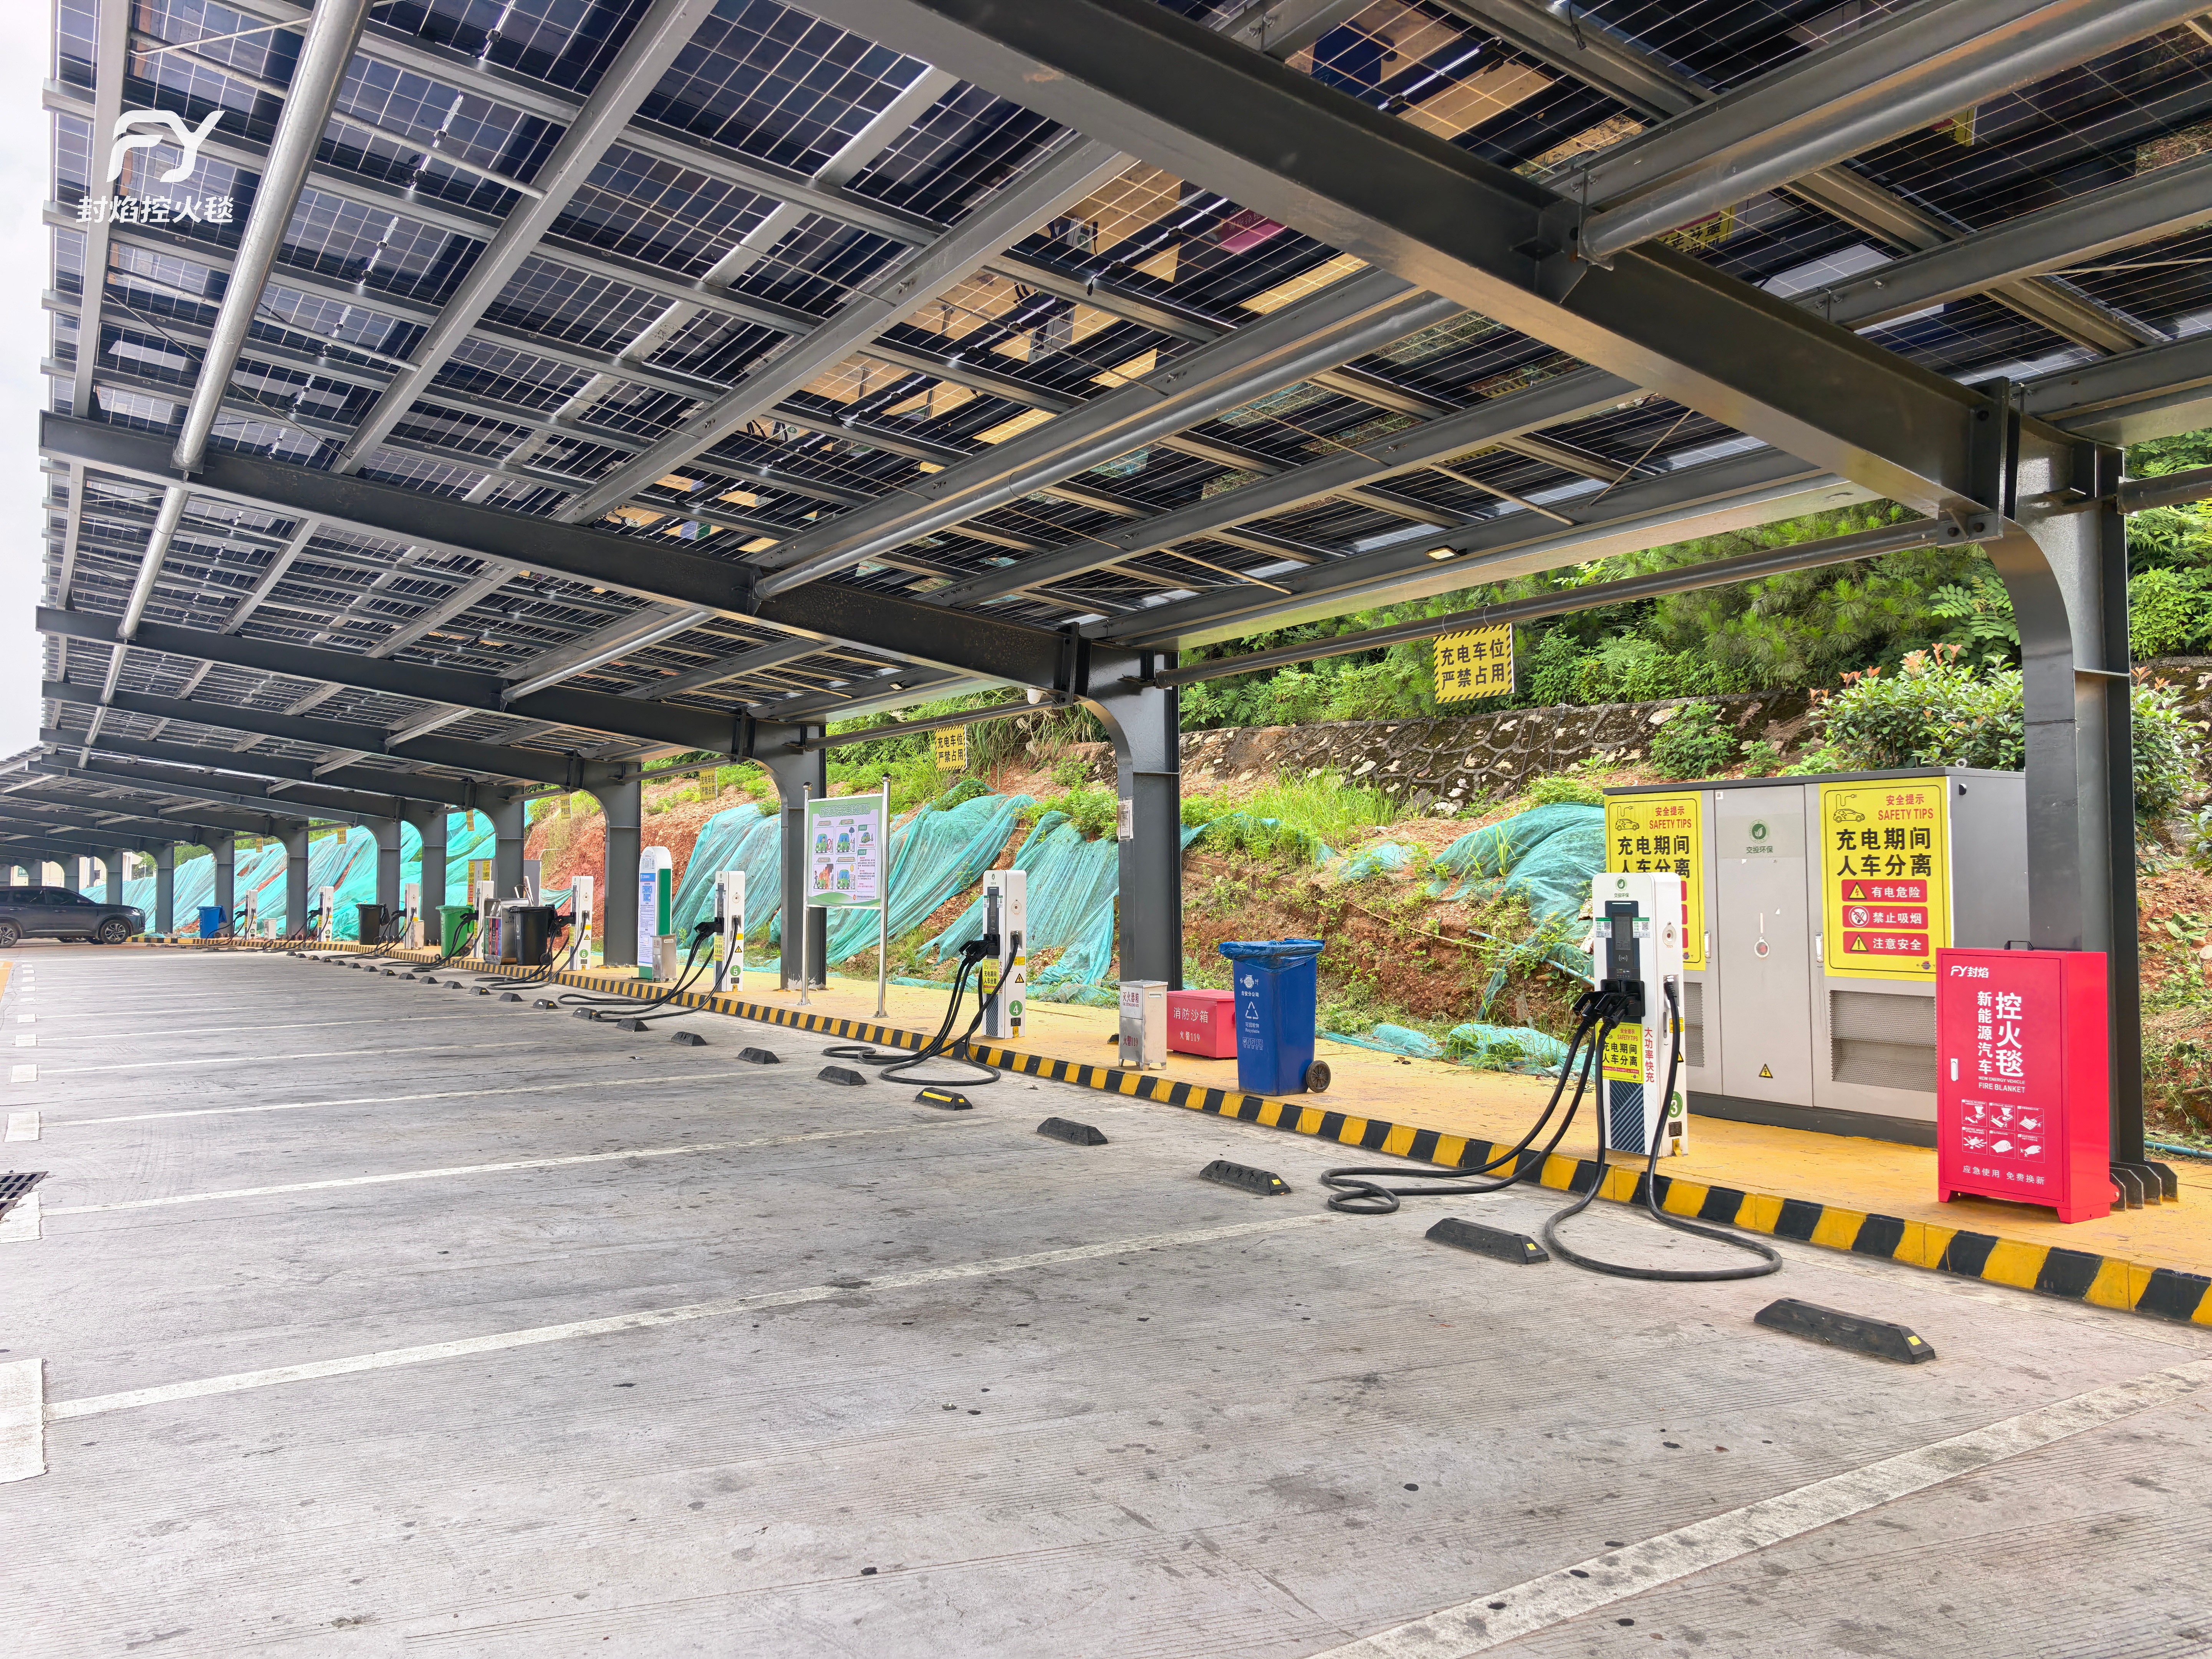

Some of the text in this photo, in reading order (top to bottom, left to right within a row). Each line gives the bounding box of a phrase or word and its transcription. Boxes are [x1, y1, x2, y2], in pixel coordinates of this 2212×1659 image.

[1440, 638, 1505, 667] 充电车位
[1442, 663, 1504, 690] 严禁占用
[937, 733, 963, 748] 充电车位
[938, 749, 963, 763] 严禁占用
[1886, 794, 1924, 806] 安全提示
[1655, 806, 1685, 816] 安全提示
[1878, 808, 1934, 821] SAFETY TIPS
[1649, 818, 1692, 829] SAFETY TIPS
[1618, 835, 1689, 855] 充电期间
[1836, 827, 1930, 851] 充电期间
[1837, 853, 1931, 877] 人车分离
[1871, 886, 1920, 898] 有电危险
[1873, 912, 1922, 924] 禁止吸烟
[1873, 938, 1921, 950] 注意安全
[1123, 992, 1139, 1003] 灭火器箱
[1013, 1005, 1019, 1014] 4
[1174, 1007, 1209, 1023] 消防沙箱
[1977, 991, 1993, 1075] 新能源汽车
[1995, 992, 2024, 1077] 控火毯
[1603, 1053, 1637, 1066] 人车分离
[1644, 1027, 1654, 1083] 大功率快充
[1995, 1084, 2025, 1093] BLANKET
[1671, 1099, 1678, 1115] 3
[1963, 1165, 2045, 1185] 应急使用 免费换新
